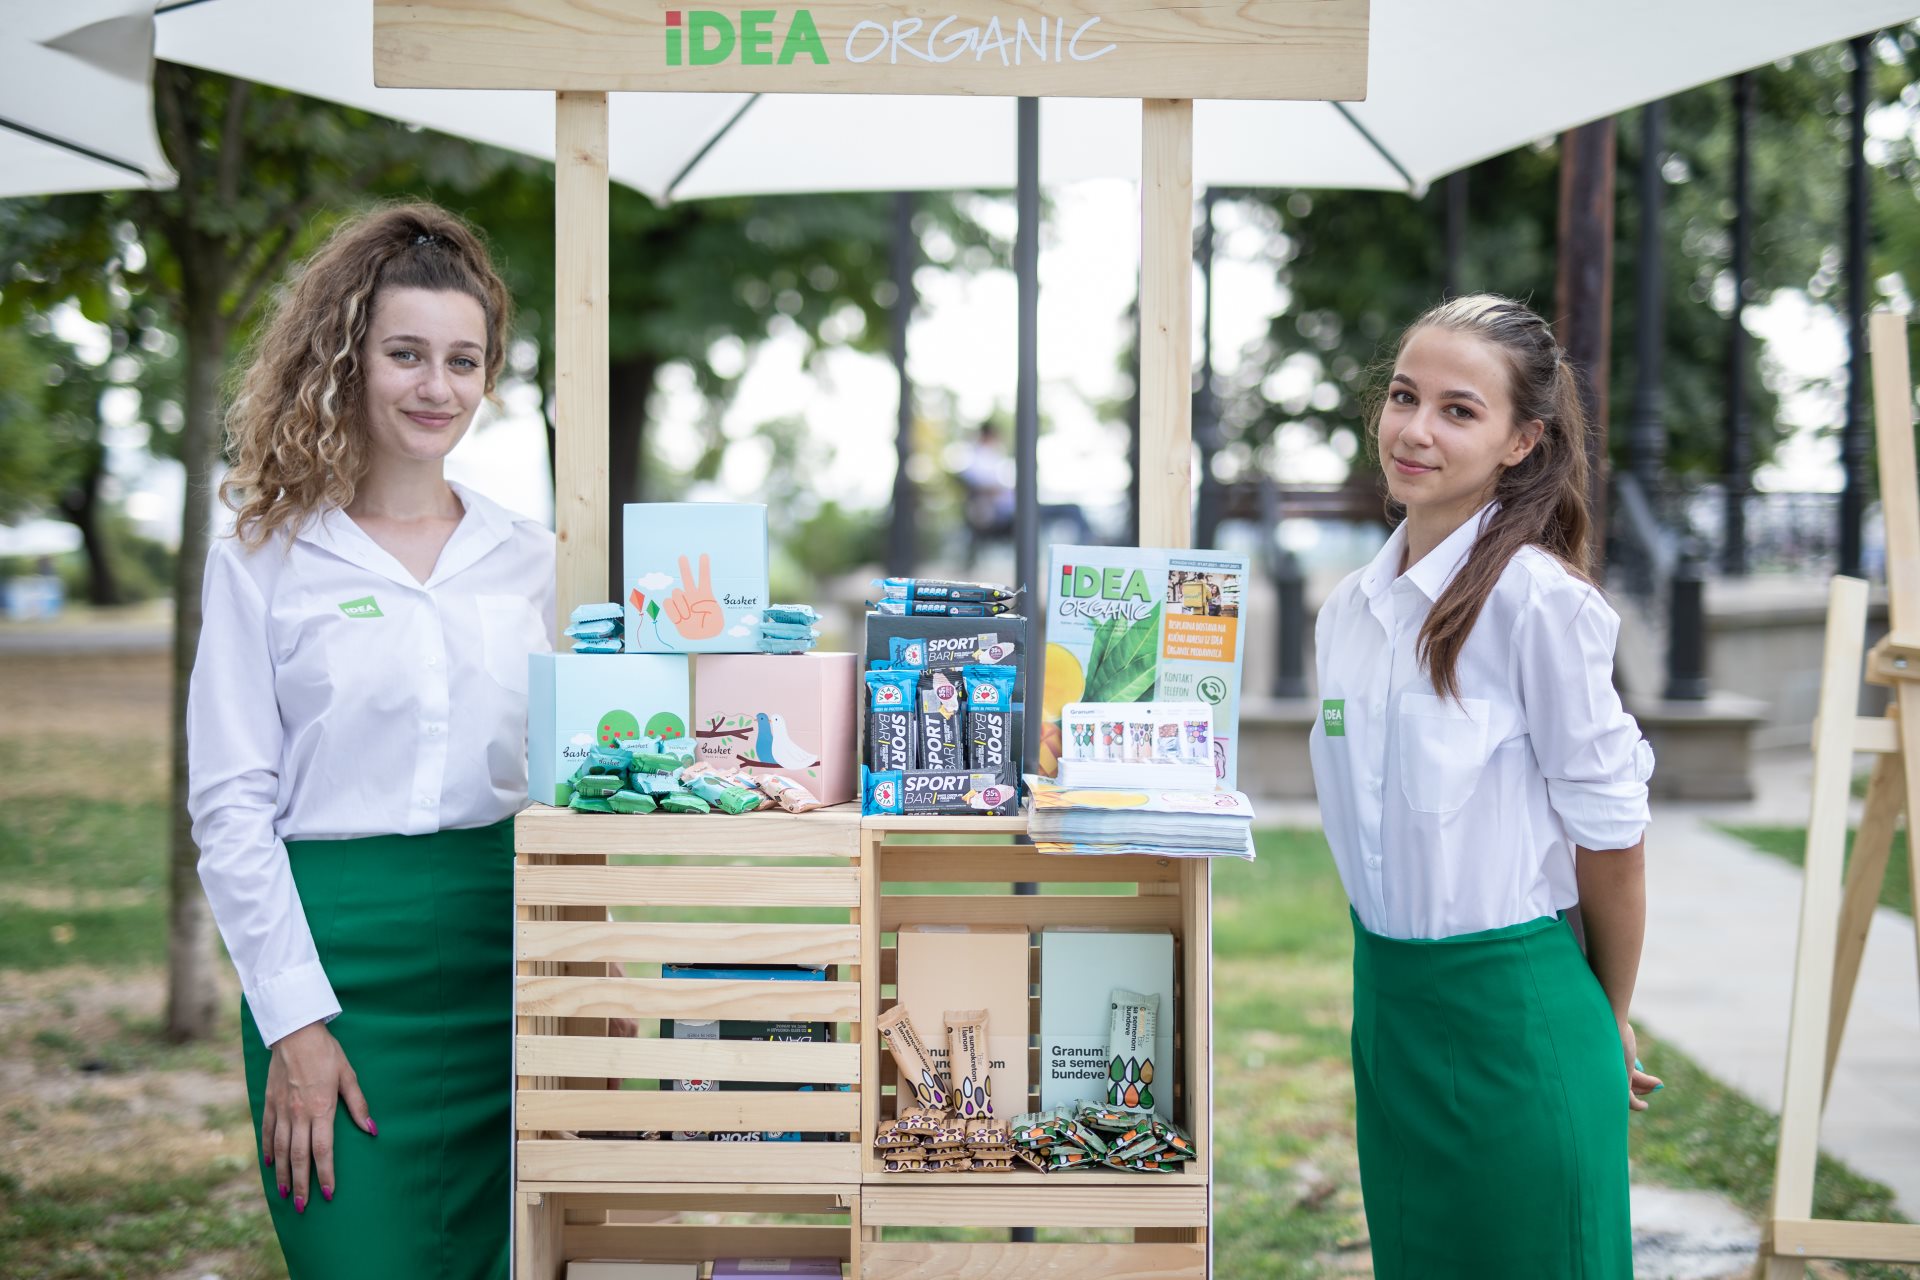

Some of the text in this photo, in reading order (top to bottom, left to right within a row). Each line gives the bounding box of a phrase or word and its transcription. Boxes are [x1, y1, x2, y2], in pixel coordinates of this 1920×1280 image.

[845, 14, 1117, 66] ORGANIC
[723, 593, 758, 606] basket
[1059, 599, 1152, 621] ORGANIC
[928, 637, 977, 652] SPORT
[1164, 672, 1193, 683] KONTAKT
[879, 687, 899, 701] VITALIA
[975, 686, 996, 700] VITALIA
[1164, 686, 1190, 697] TELEFON
[892, 713, 906, 770] SPORT
[988, 713, 1002, 765] SPOR
[562, 746, 590, 758] bask
[701, 743, 732, 755] basket
[904, 775, 968, 791] SPORT
[876, 785, 891, 804] VITALIA
[897, 1026, 911, 1047] lanom
[1130, 1016, 1138, 1051] semenom
[905, 1029, 931, 1072] suncokretom
[1052, 1045, 1103, 1057] Granum
[969, 1036, 977, 1082] suncokretom
[1051, 1059, 1066, 1068] sa
[1051, 1069, 1105, 1080] bundeve
